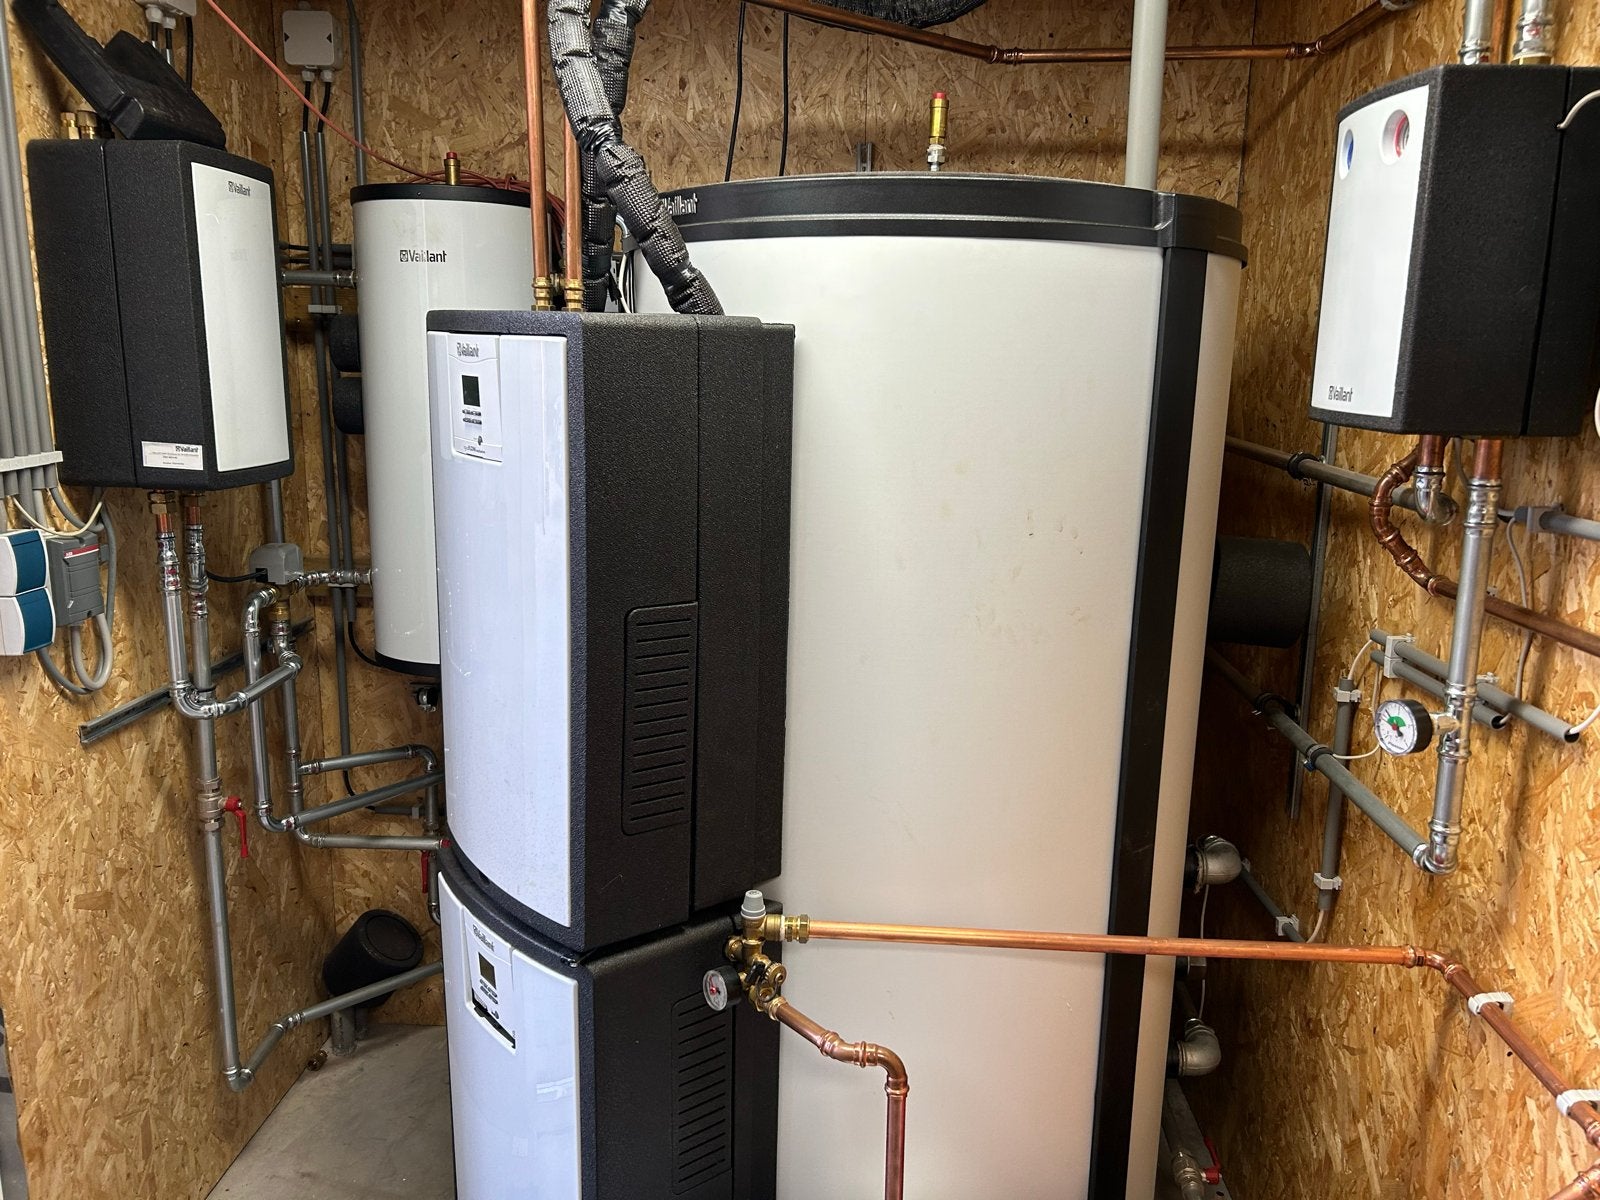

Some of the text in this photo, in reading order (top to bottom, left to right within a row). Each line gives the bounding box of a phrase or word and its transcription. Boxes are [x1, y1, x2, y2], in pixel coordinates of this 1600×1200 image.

[234, 183, 250, 196] Vaillant
[461, 342, 479, 357] Vaillant
[1333, 386, 1353, 402] Vaillant
